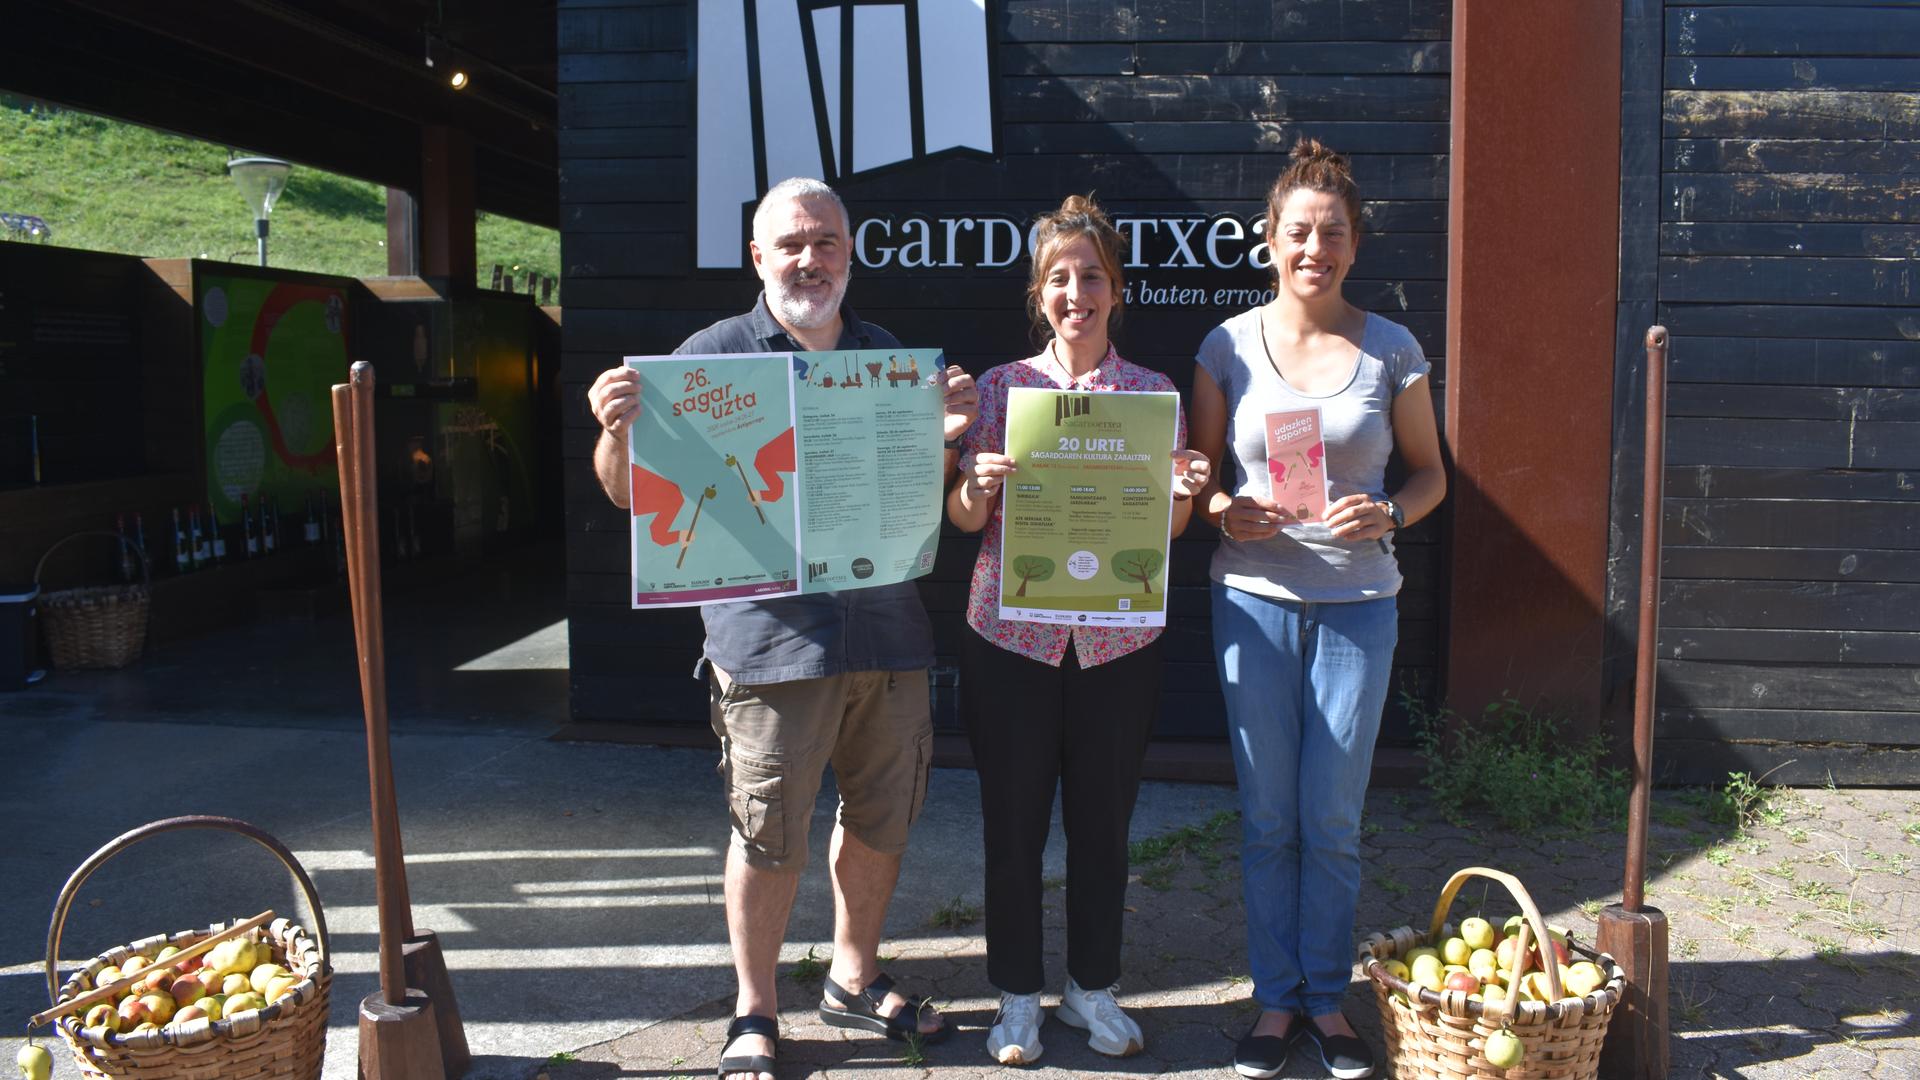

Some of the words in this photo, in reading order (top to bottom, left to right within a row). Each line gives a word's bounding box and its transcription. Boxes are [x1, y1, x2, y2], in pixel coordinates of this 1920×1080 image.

[1140, 279, 1208, 304] baten
[1213, 288, 1275, 305] erroa
[684, 367, 711, 392] 26.
[672, 383, 733, 417] sagar
[711, 392, 757, 420] uzta
[1274, 416, 1312, 436] udazken
[1276, 423, 1313, 443] zaporez
[1058, 437, 1080, 451] 20
[1085, 438, 1125, 452] URTE
[1031, 451, 1082, 460] SAGARDOAREN
[1083, 453, 1112, 461] KULTURA
